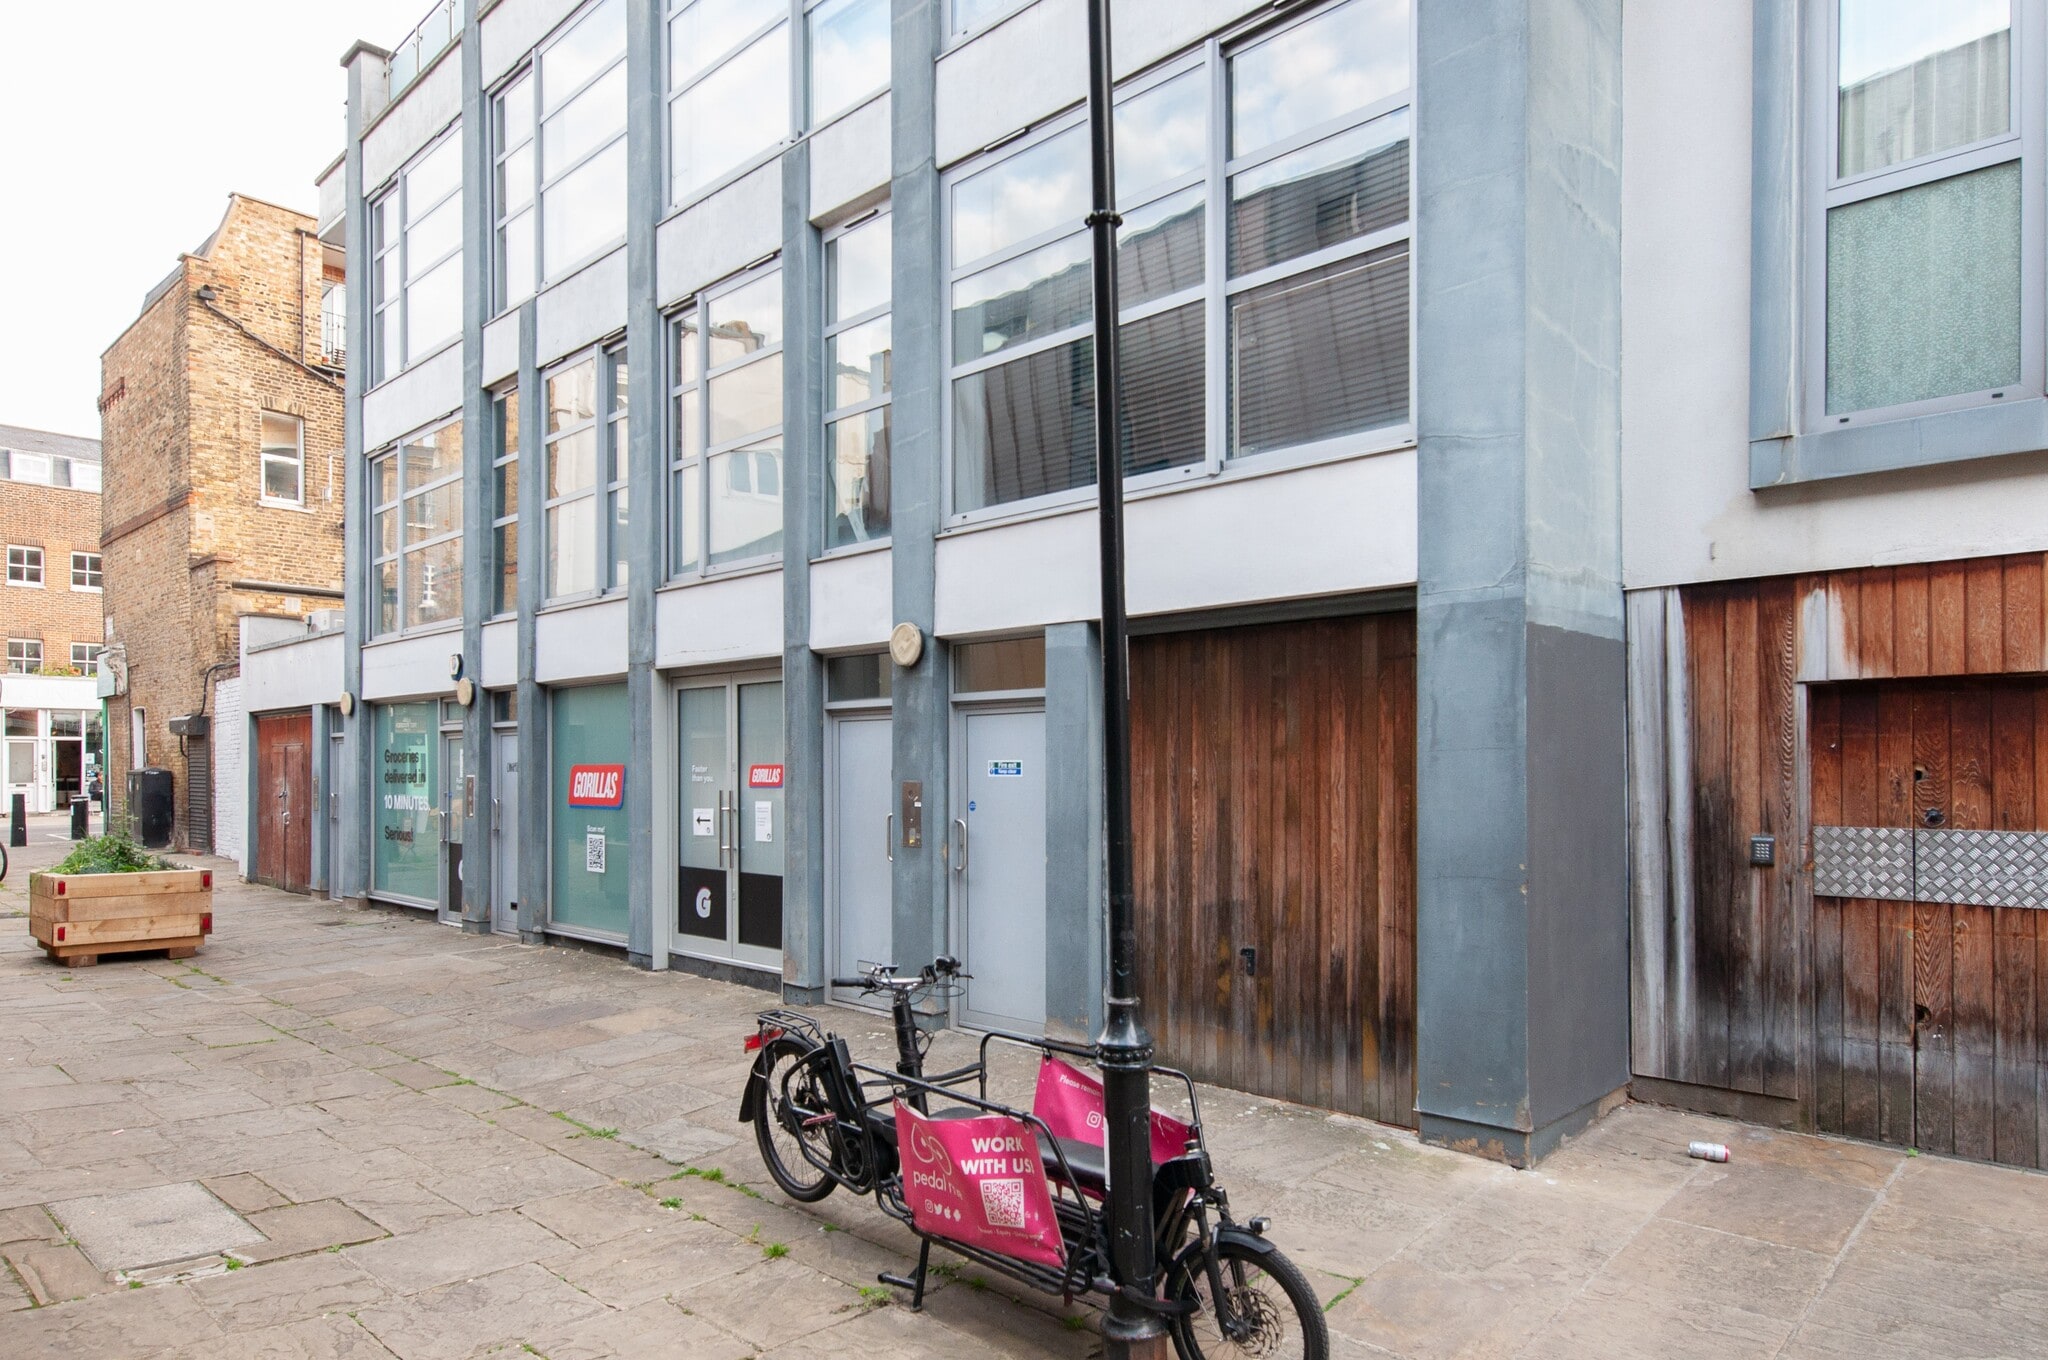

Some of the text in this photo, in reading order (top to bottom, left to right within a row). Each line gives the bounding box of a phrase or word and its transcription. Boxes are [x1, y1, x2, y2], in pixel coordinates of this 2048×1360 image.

[384, 748, 419, 763] Groceries
[384, 769, 426, 784] delivered in
[752, 768, 781, 783] GORILLAS
[573, 772, 618, 799] GORILLAS
[384, 794, 393, 810] 10
[384, 825, 414, 842] Serious!
[696, 887, 711, 919] G
[1059, 1074, 1081, 1089] Please
[971, 1136, 1025, 1153] WORK
[960, 1157, 1035, 1176] WITH US!
[913, 1170, 947, 1192] pedal
